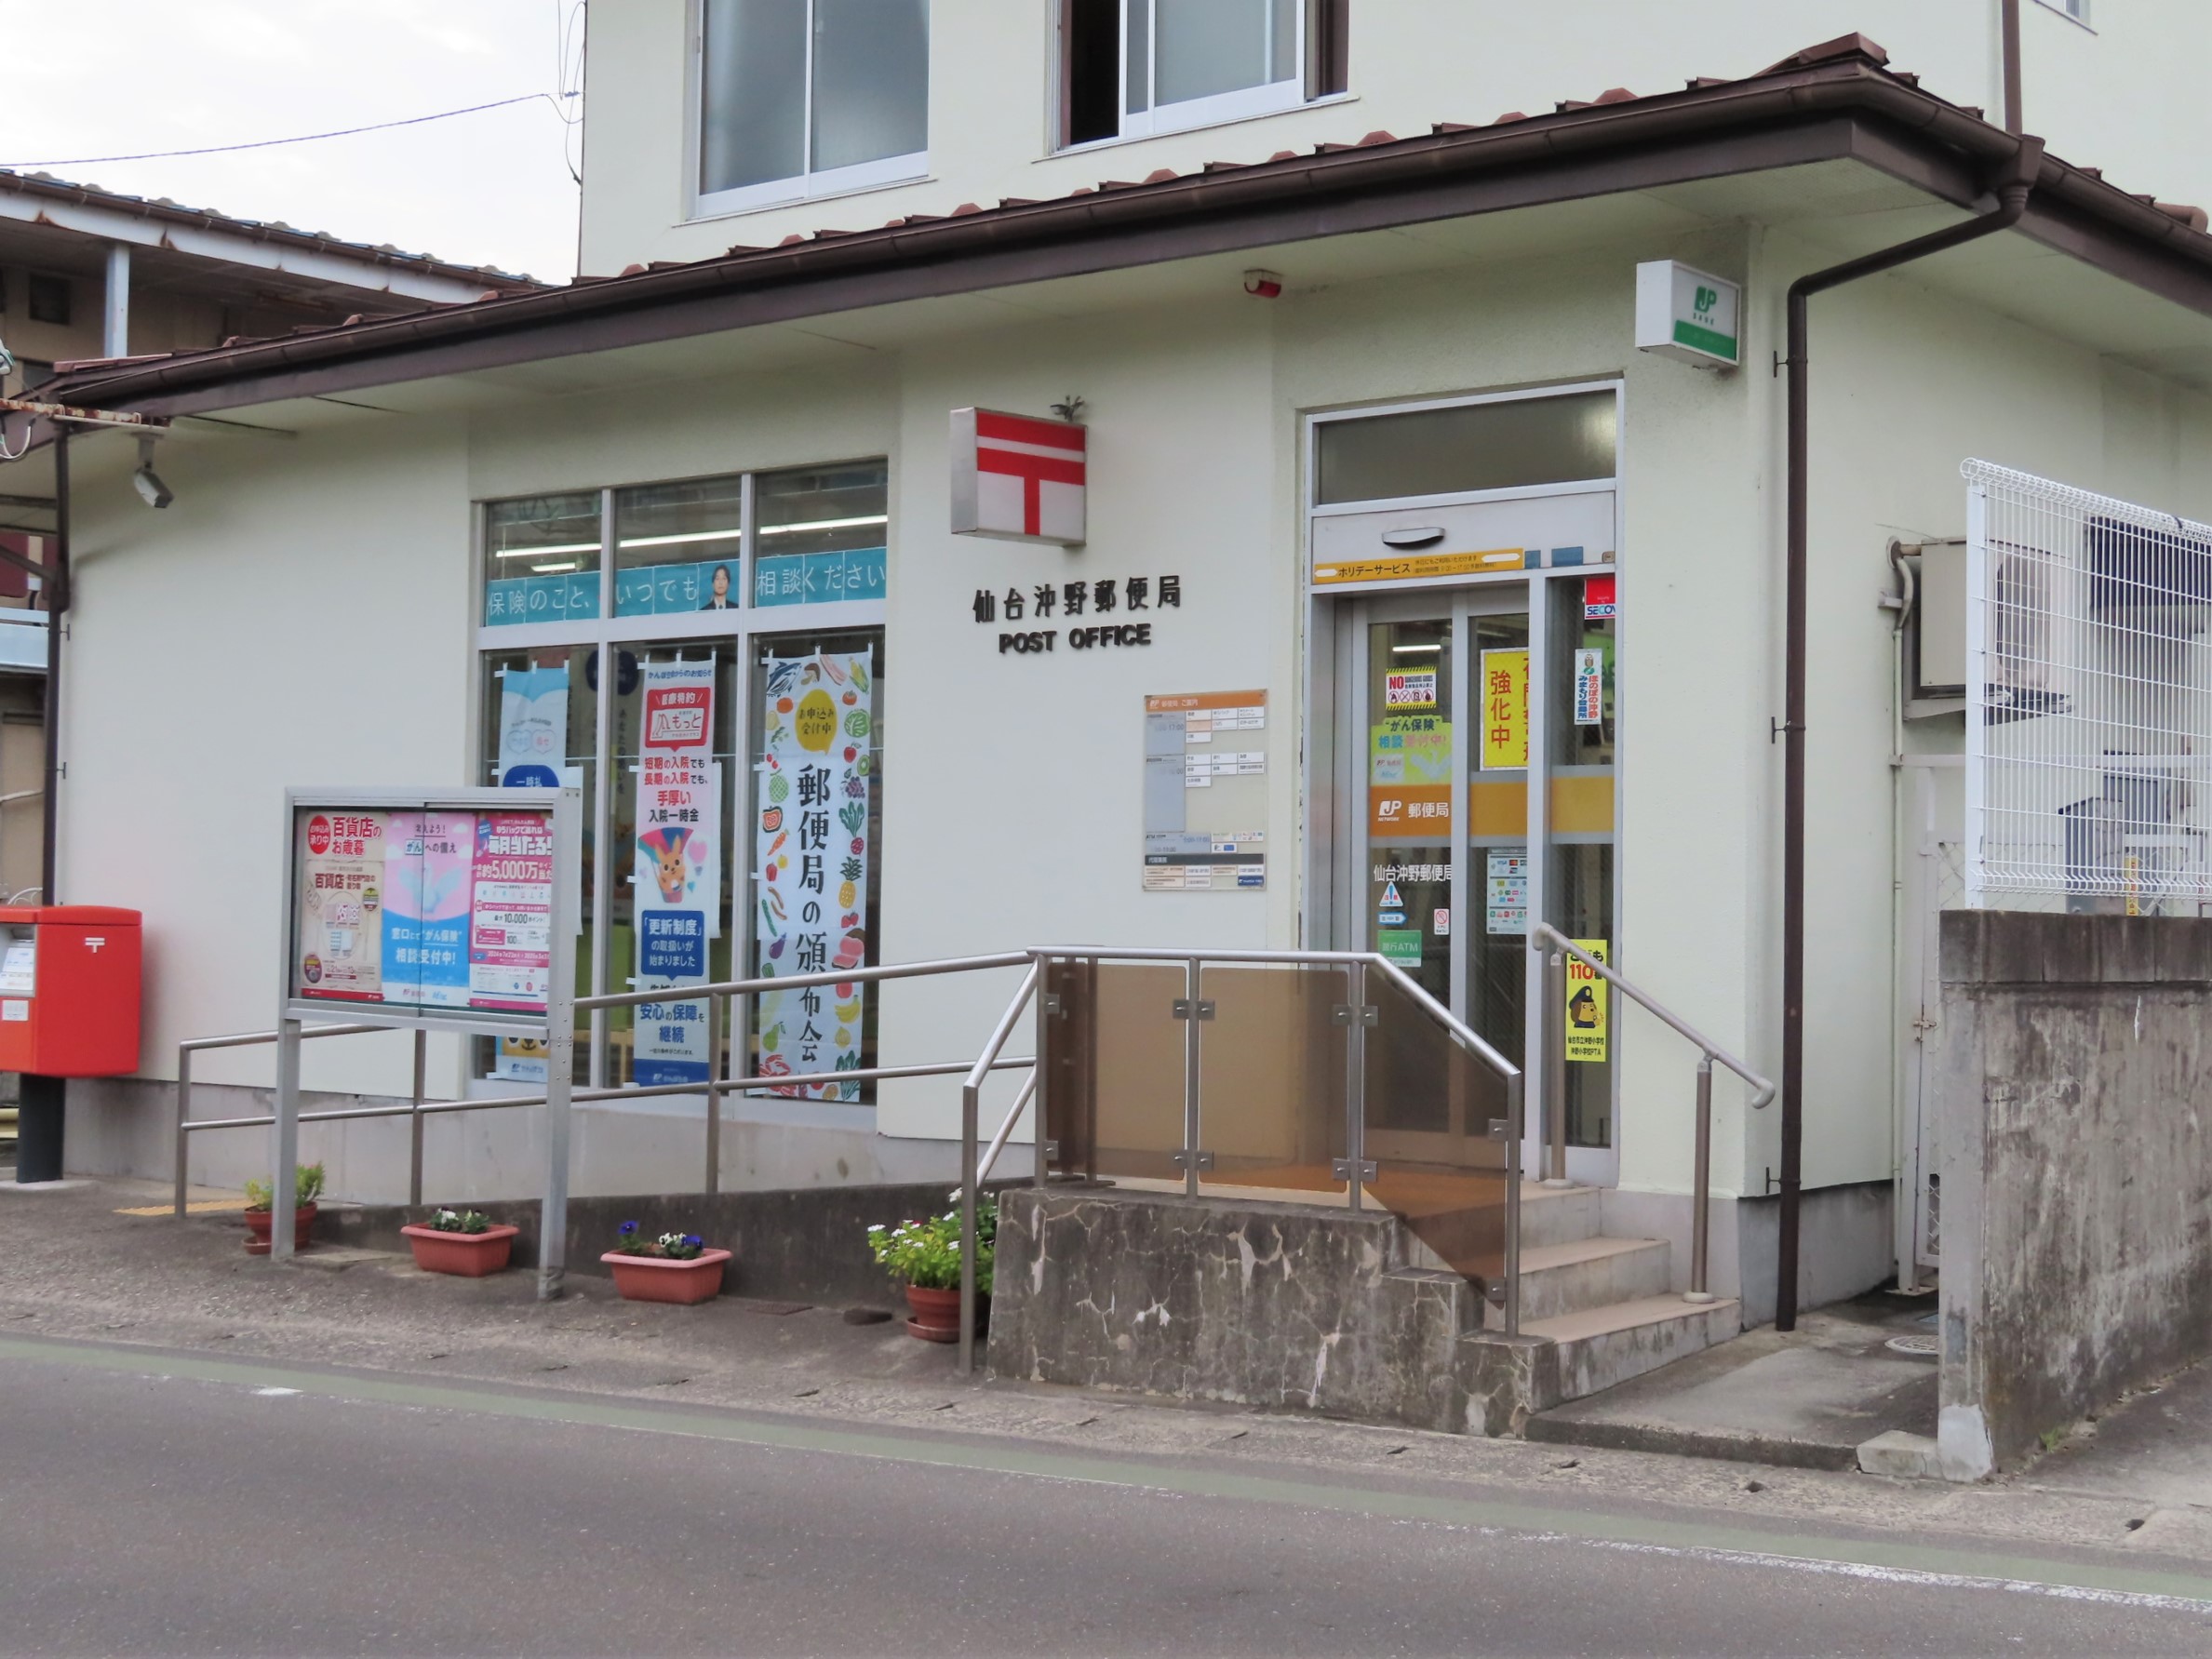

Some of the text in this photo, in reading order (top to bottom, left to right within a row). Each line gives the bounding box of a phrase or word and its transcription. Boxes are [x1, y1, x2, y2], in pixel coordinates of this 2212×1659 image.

[1338, 563, 1411, 578] ホリデーサービス
[488, 564, 886, 616] 保険のこと、 いつでも 相談ください
[972, 575, 1181, 622] 仙台沖野郵便局
[999, 622, 1151, 654] POST OFFICE
[1389, 676, 1404, 689] NO
[662, 691, 696, 705] 医療特約
[1490, 669, 1512, 750] 強化中
[672, 714, 702, 729] もっと
[800, 721, 832, 736] 受付中
[644, 756, 705, 769] 短期の入院でも
[644, 771, 708, 785] 長期の入院でも、
[657, 790, 691, 806] 手厚い
[649, 809, 700, 823] 入院一時金
[1378, 800, 1449, 819] JP 郵便局
[332, 817, 382, 838] 百貨店の
[309, 835, 329, 846] 承り中
[331, 839, 365, 856] お歳暮
[1374, 863, 1452, 882] 仙台沖野郵便局
[315, 873, 344, 890] 百貨店
[796, 763, 831, 1063] 郵便局の頒布会
[644, 917, 703, 937] 「更新制度」
[651, 940, 694, 952] の取扱いが
[395, 947, 456, 966] 相談受付中!
[649, 955, 696, 968] 始まりました
[640, 1003, 704, 1023] 安心の保障を
[659, 1025, 685, 1043] 継続
